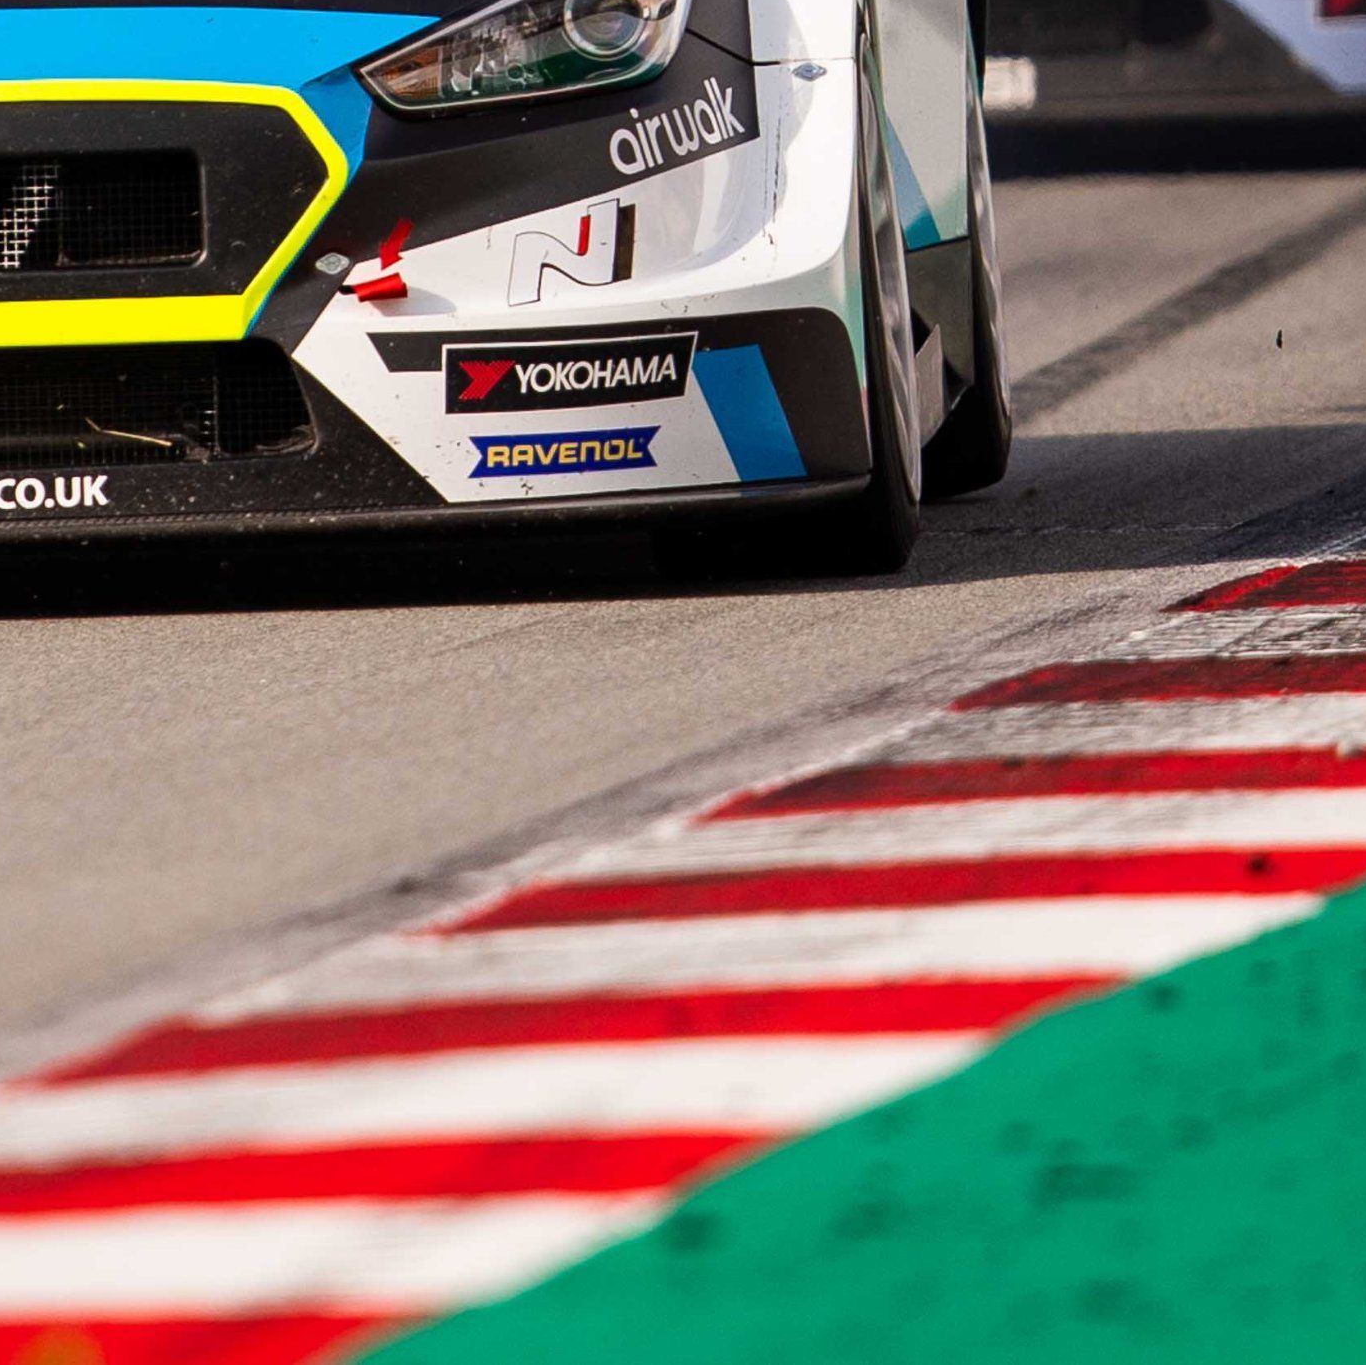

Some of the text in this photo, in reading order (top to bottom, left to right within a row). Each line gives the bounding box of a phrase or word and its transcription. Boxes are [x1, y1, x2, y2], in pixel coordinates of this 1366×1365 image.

[609, 77, 746, 175] airwalk
[514, 352, 678, 396] YOKOHAMA
[486, 437, 645, 469] RAVENOL
